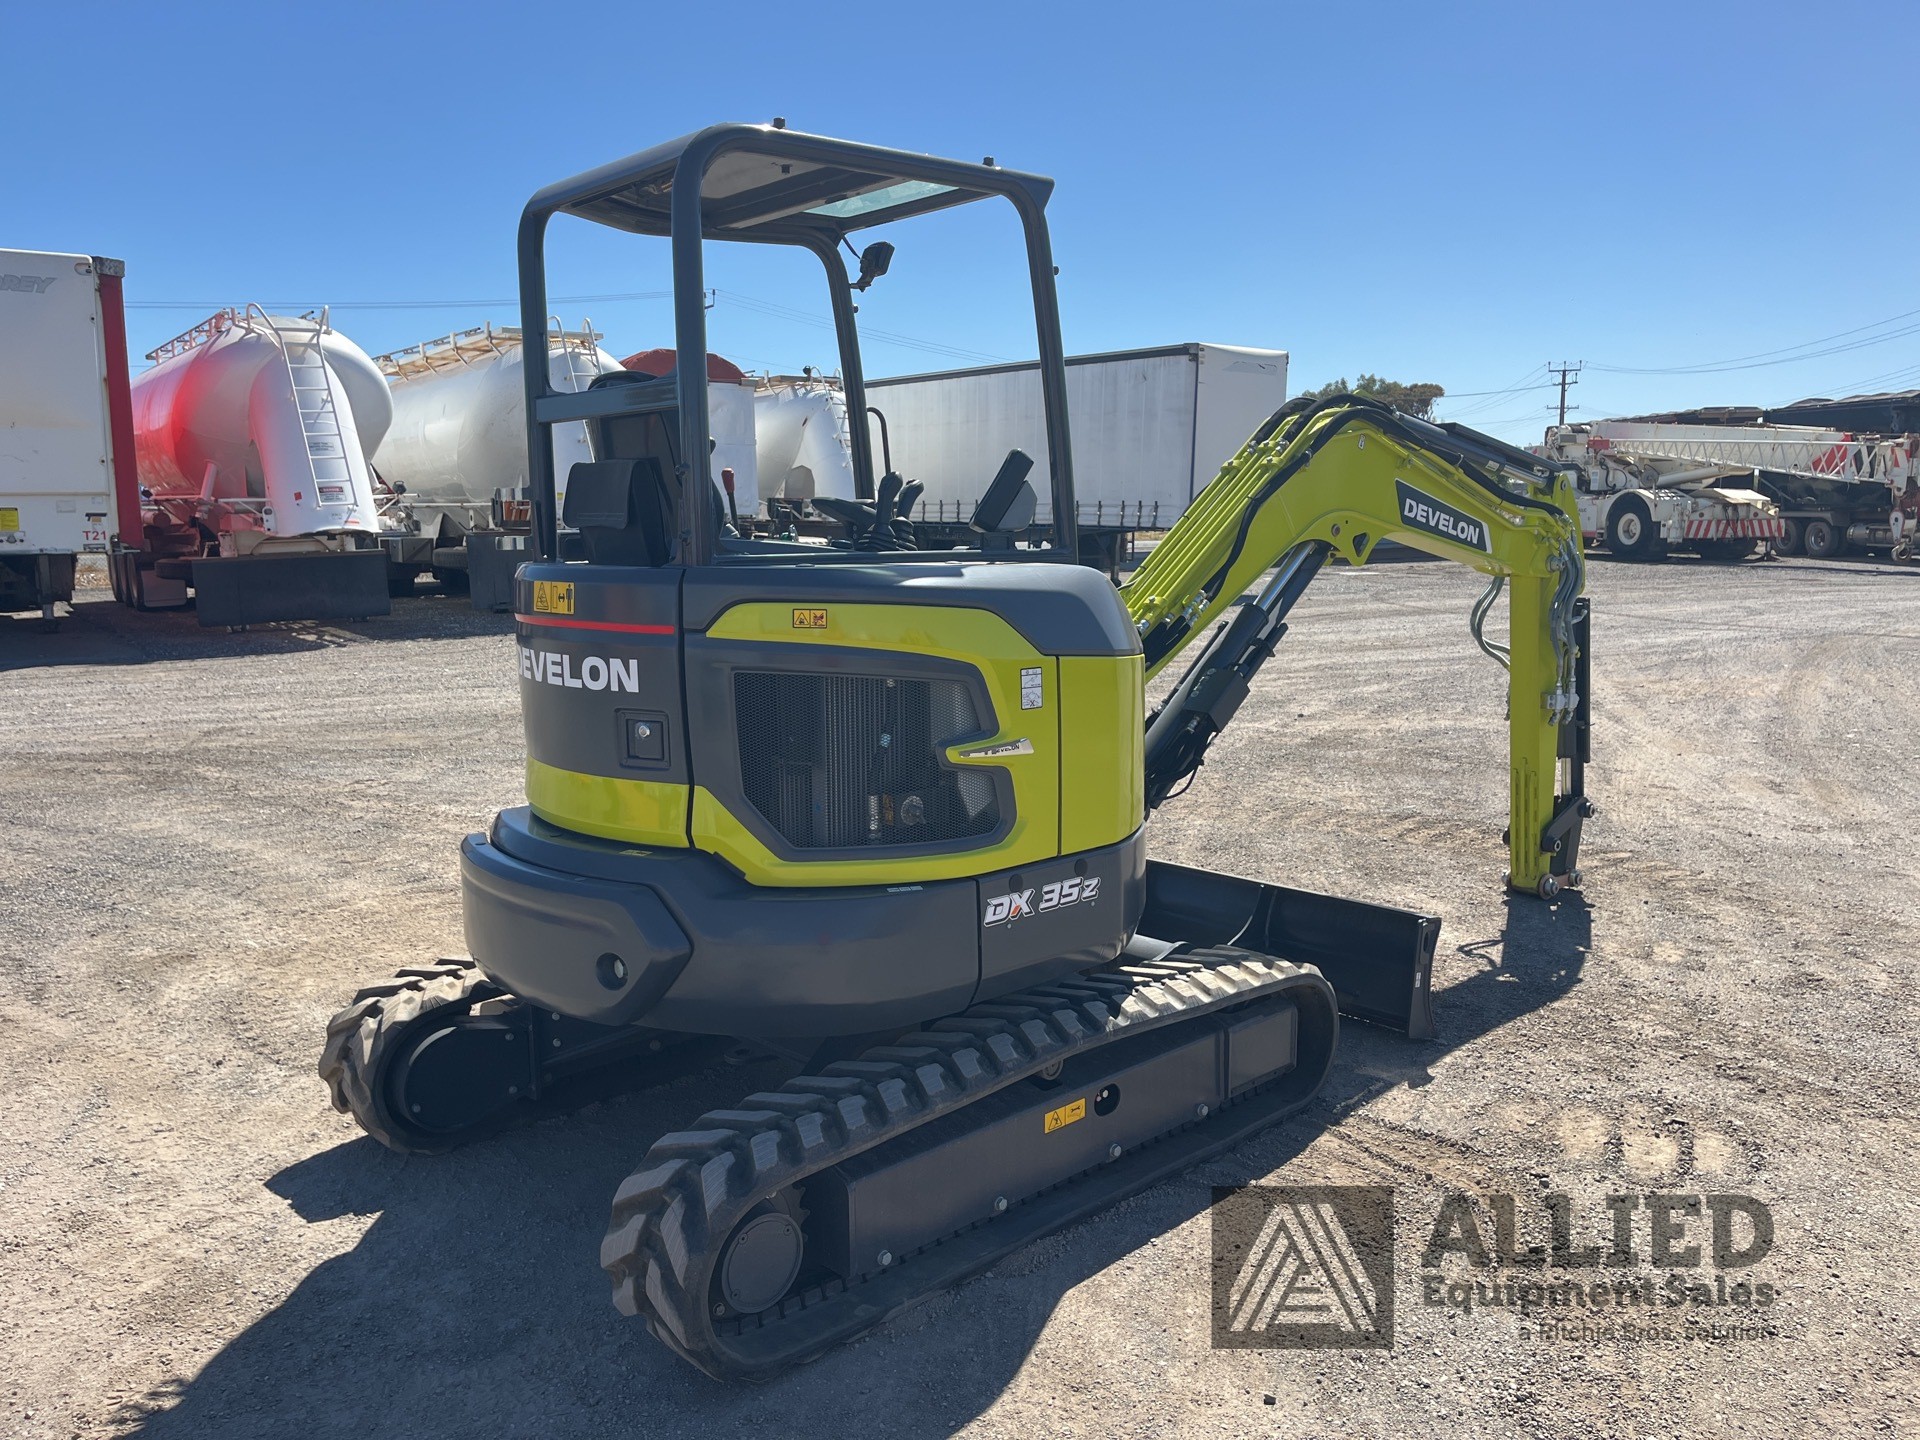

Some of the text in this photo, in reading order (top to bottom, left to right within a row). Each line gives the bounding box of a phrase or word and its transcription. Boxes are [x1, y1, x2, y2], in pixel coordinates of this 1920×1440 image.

[0, 274, 58, 294] REY
[1404, 498, 1479, 544] DEVELON
[82, 531, 107, 541] T21
[984, 889, 1035, 927] DX
